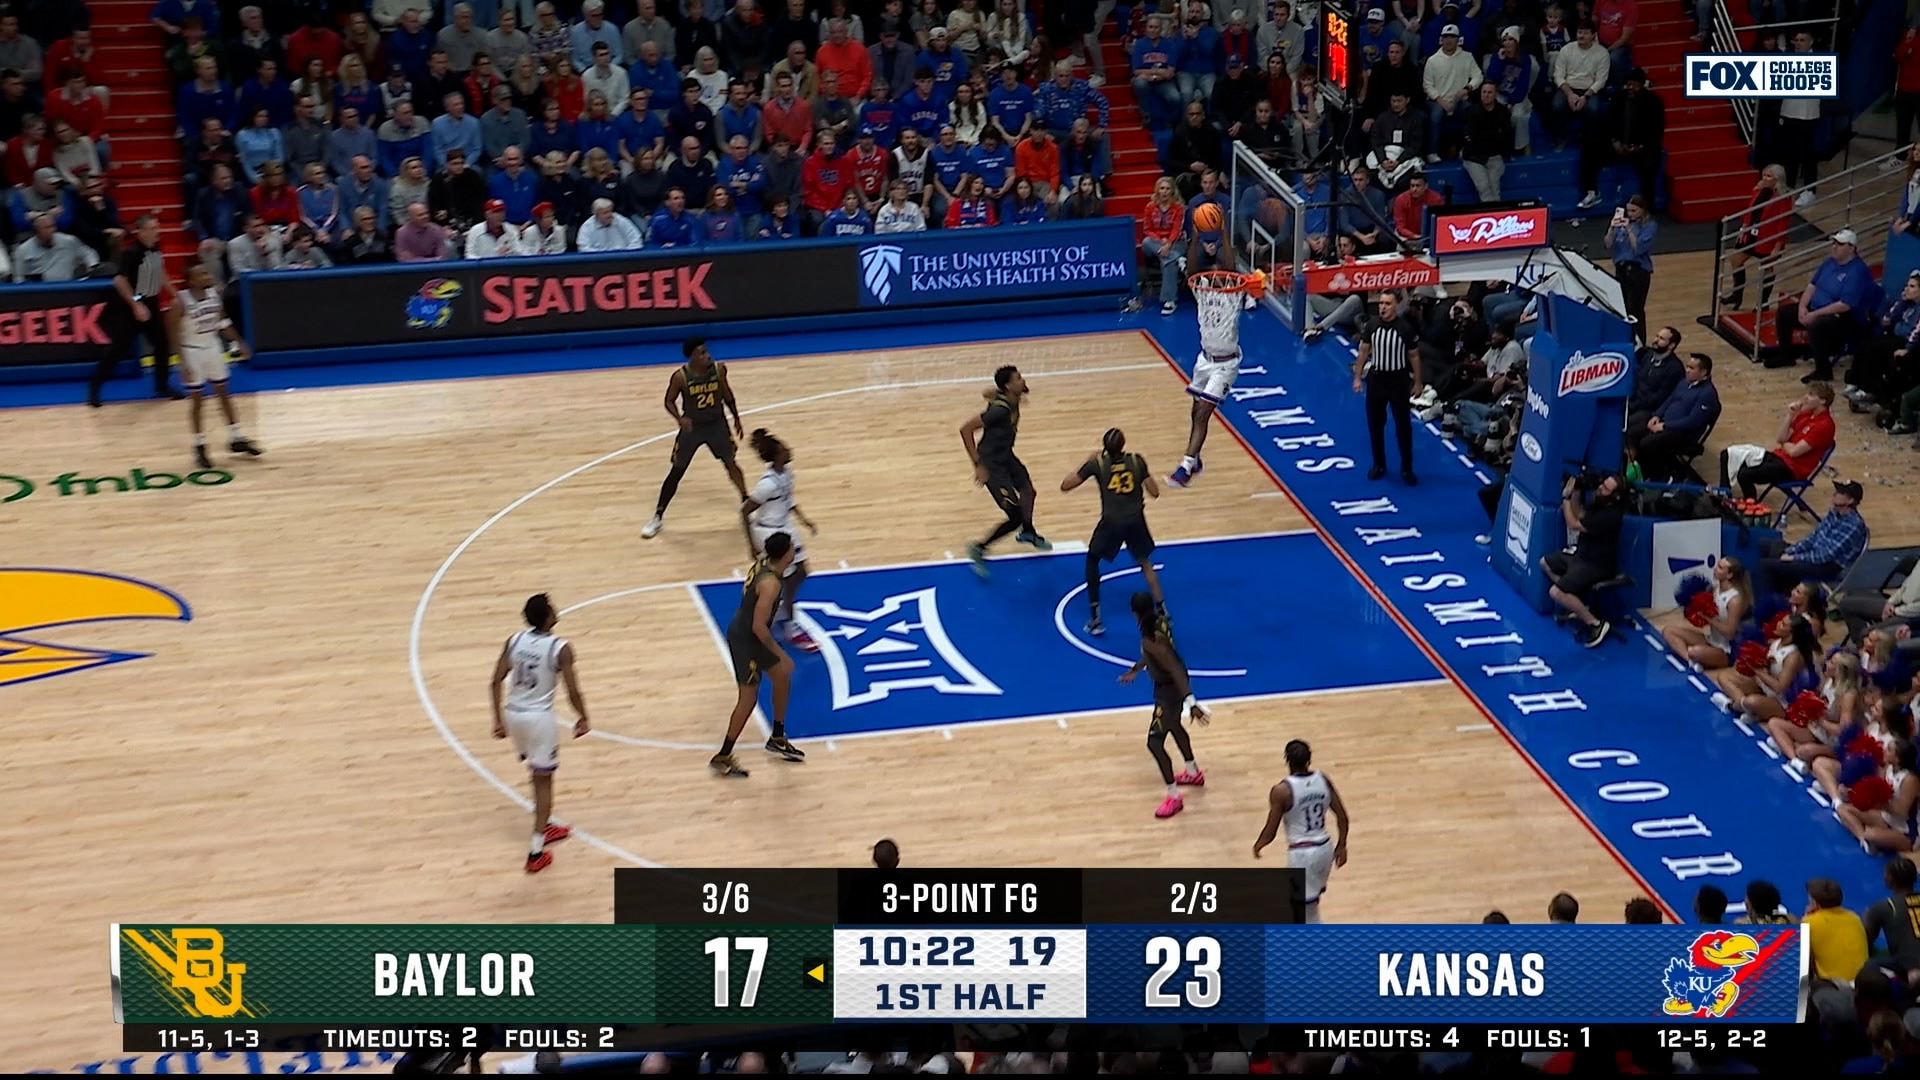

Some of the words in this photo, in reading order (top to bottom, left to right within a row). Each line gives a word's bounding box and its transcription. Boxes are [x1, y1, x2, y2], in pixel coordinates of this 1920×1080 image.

[1471, 214, 1535, 243] Dillons
[908, 255, 949, 273] THE
[952, 248, 1063, 270] UNIVERSITY
[1065, 246, 1090, 262] OF
[911, 272, 982, 292] KANSAS
[986, 265, 1056, 286] HEALTH
[1060, 262, 1126, 282] SYSTEM
[482, 261, 718, 324] SEATGEEK
[0, 302, 111, 345] GEEK
[689, 381, 719, 396] BAYLOR
[1561, 359, 1623, 392] LIBMAN
[697, 393, 715, 409] 24
[48, 467, 234, 497] fnbo
[1107, 470, 1135, 495] 43
[1331, 496, 1588, 715] NAISMITH
[1300, 802, 1325, 833] 13
